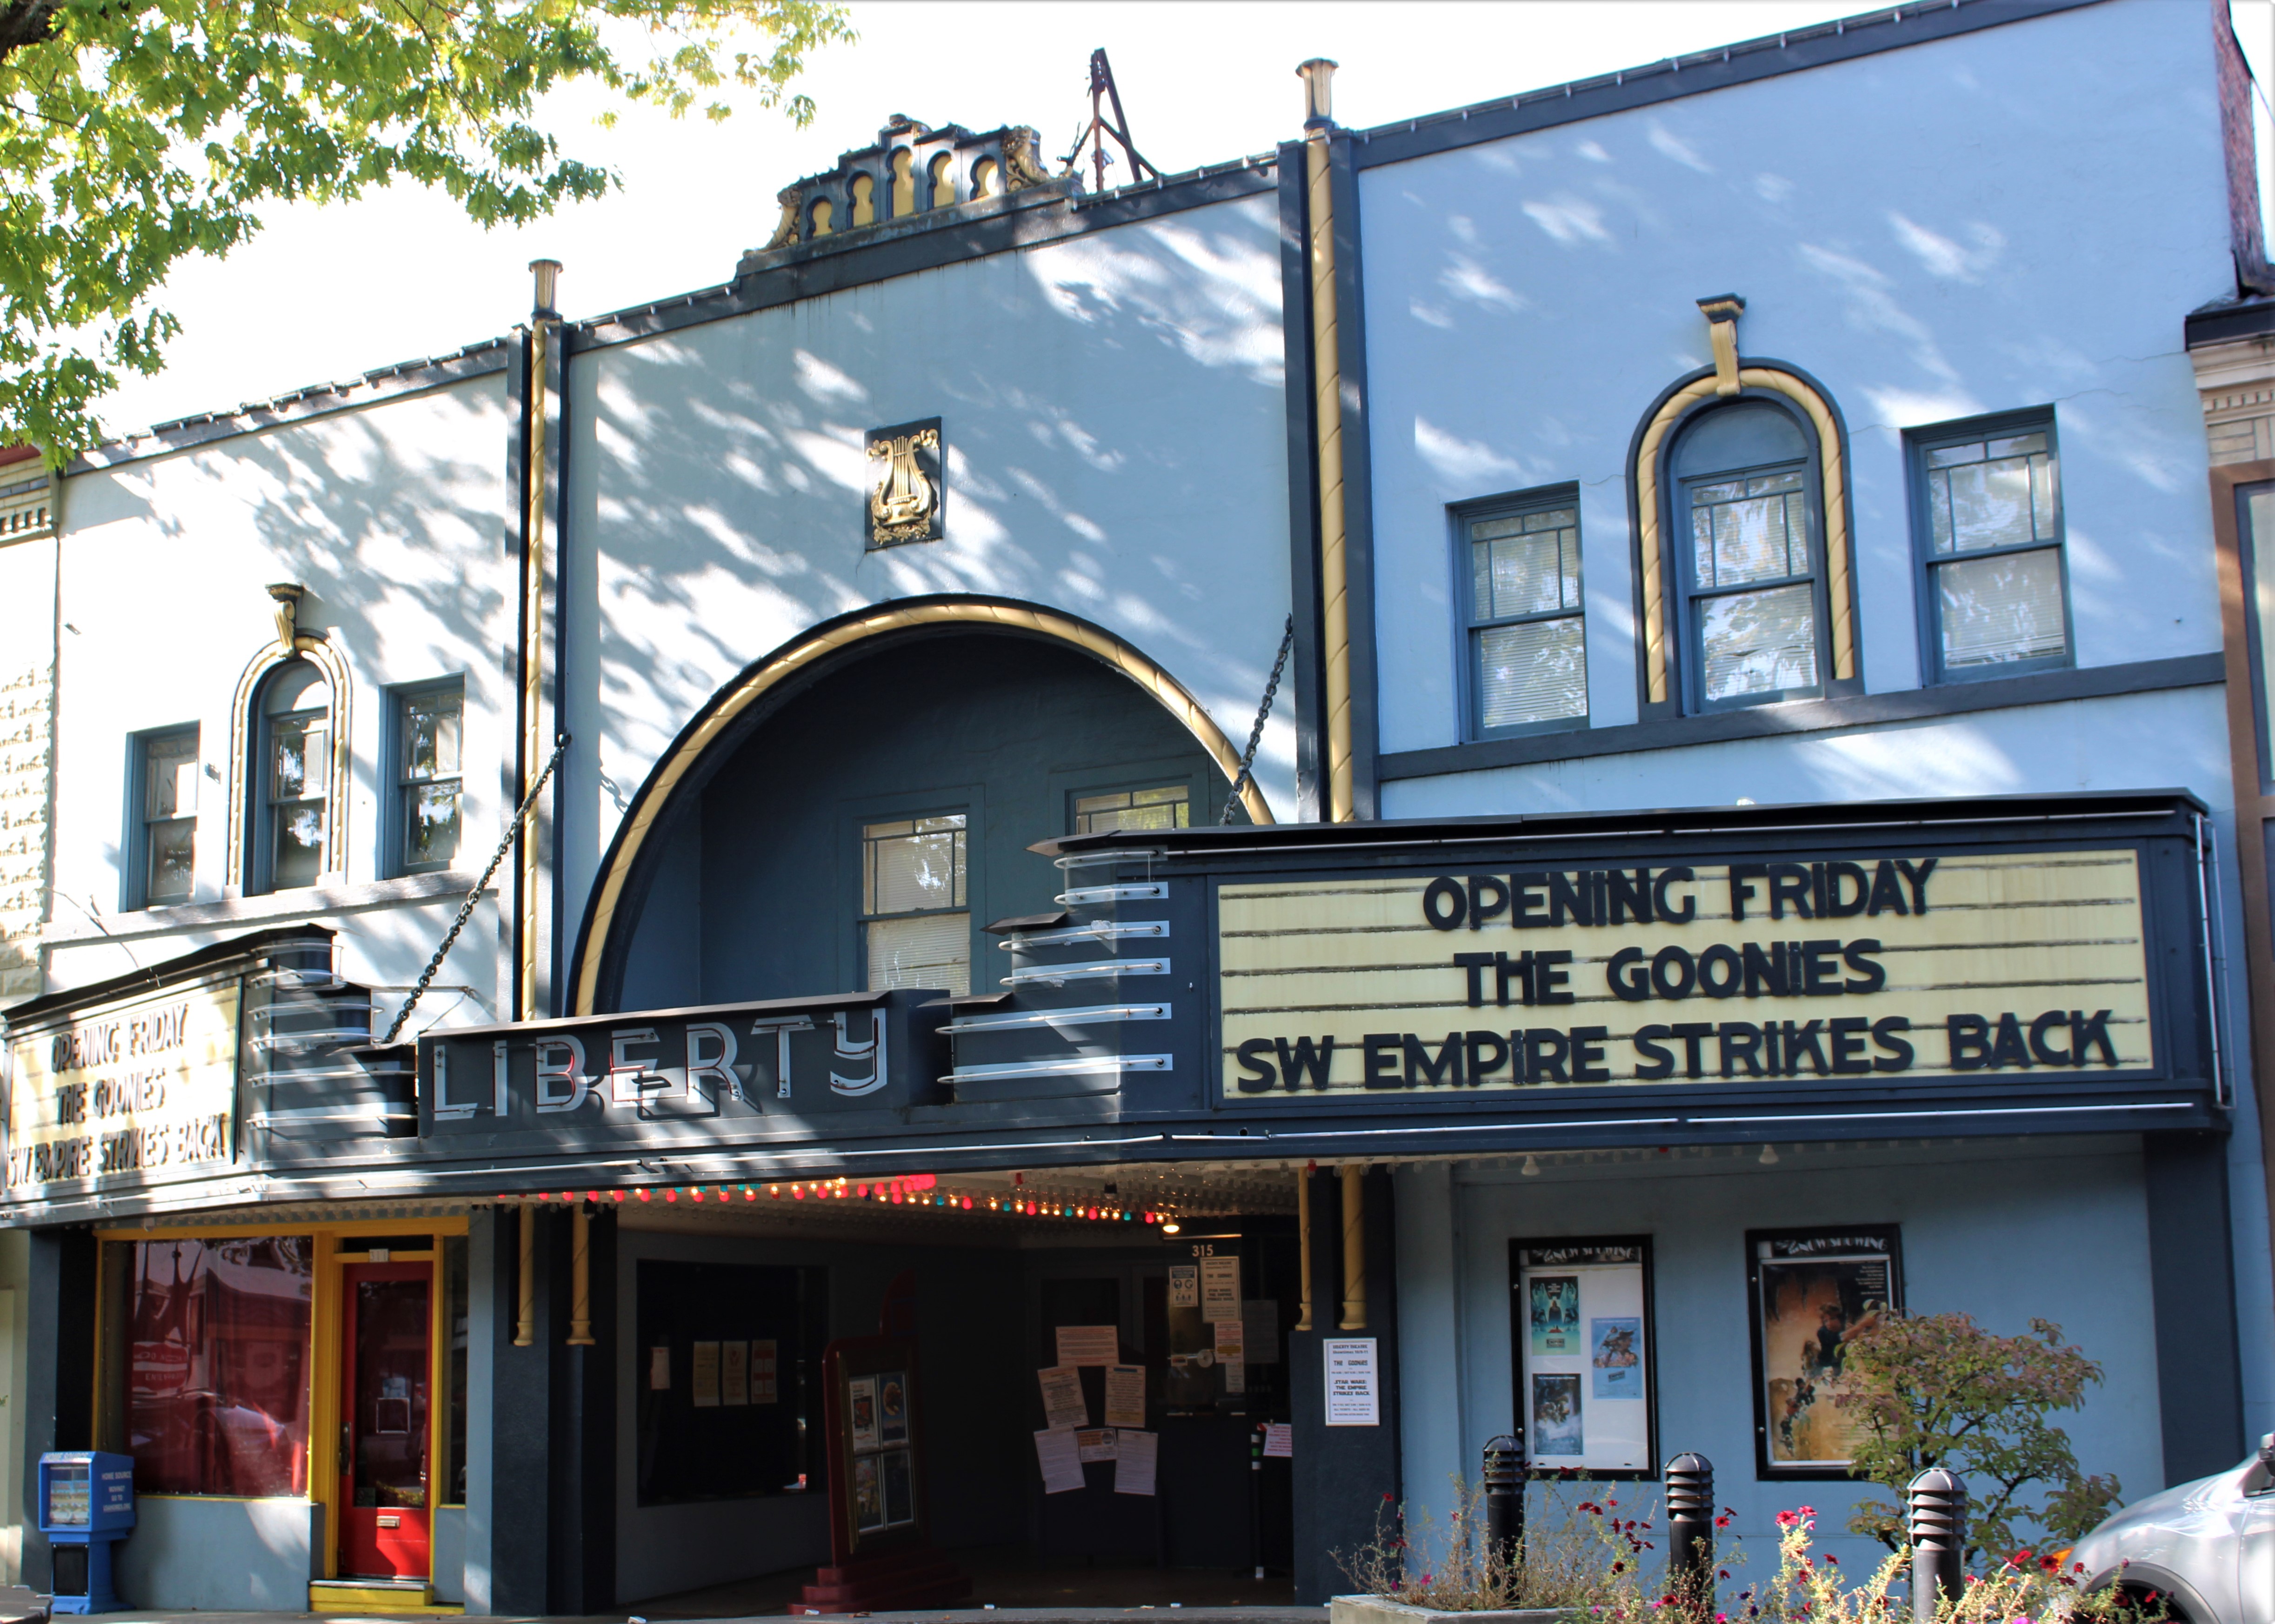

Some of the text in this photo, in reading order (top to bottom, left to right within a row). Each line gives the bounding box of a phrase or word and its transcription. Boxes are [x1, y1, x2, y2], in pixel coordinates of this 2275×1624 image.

[1422, 858, 1937, 932] OPENING FRIDAY
[1454, 939, 1885, 1007] THE GOONIES
[52, 1003, 188, 1072] OPENING FRIDAY
[432, 1008, 887, 1121] LIBERTY
[1235, 1009, 2118, 1095] SW EMPIRE STRIKES BACK
[56, 1067, 166, 1125] THE GOONIES
[35, 1135, 93, 1182] EMPIRE
[98, 1124, 169, 1172] STRIKES
[177, 1113, 227, 1162] BACK
[1192, 1245, 1214, 1257] 315
